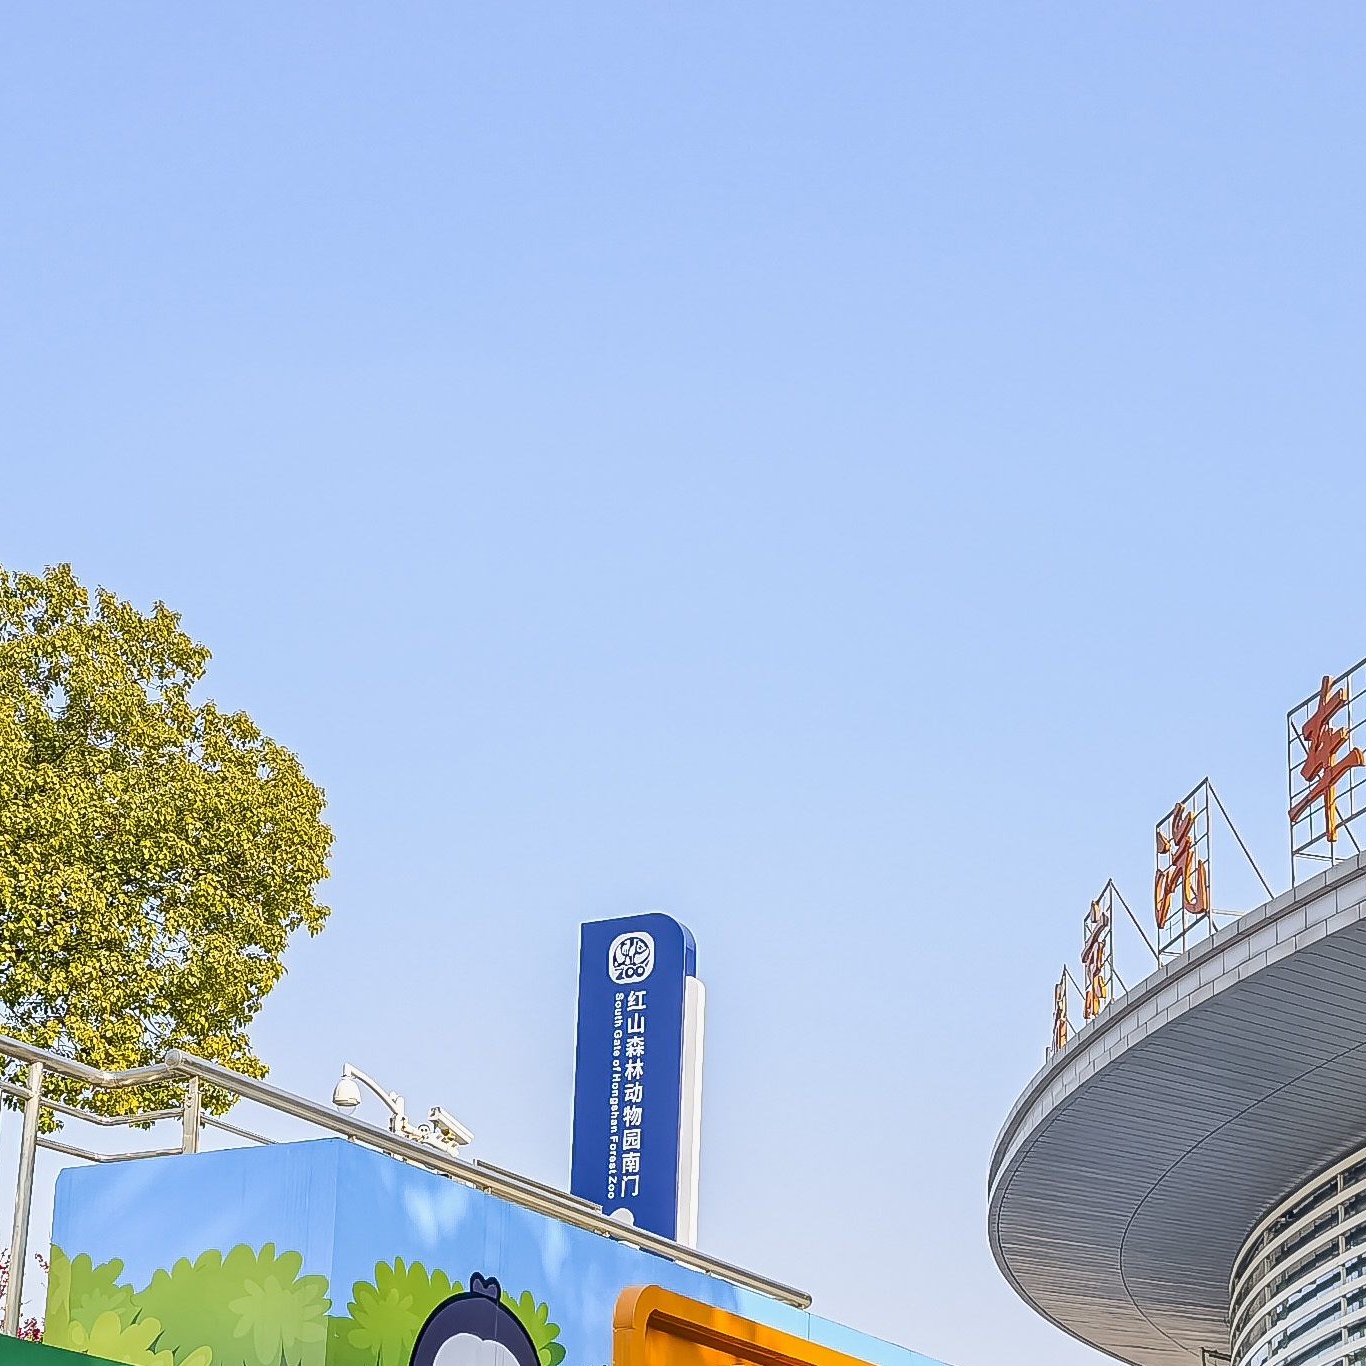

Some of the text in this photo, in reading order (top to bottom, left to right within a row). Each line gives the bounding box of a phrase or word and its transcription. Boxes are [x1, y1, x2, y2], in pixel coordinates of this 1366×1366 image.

[607, 992, 624, 1199] South Gate of Hongshan Forest Zoo
[620, 990, 647, 1198] 红山森林动物园南门
